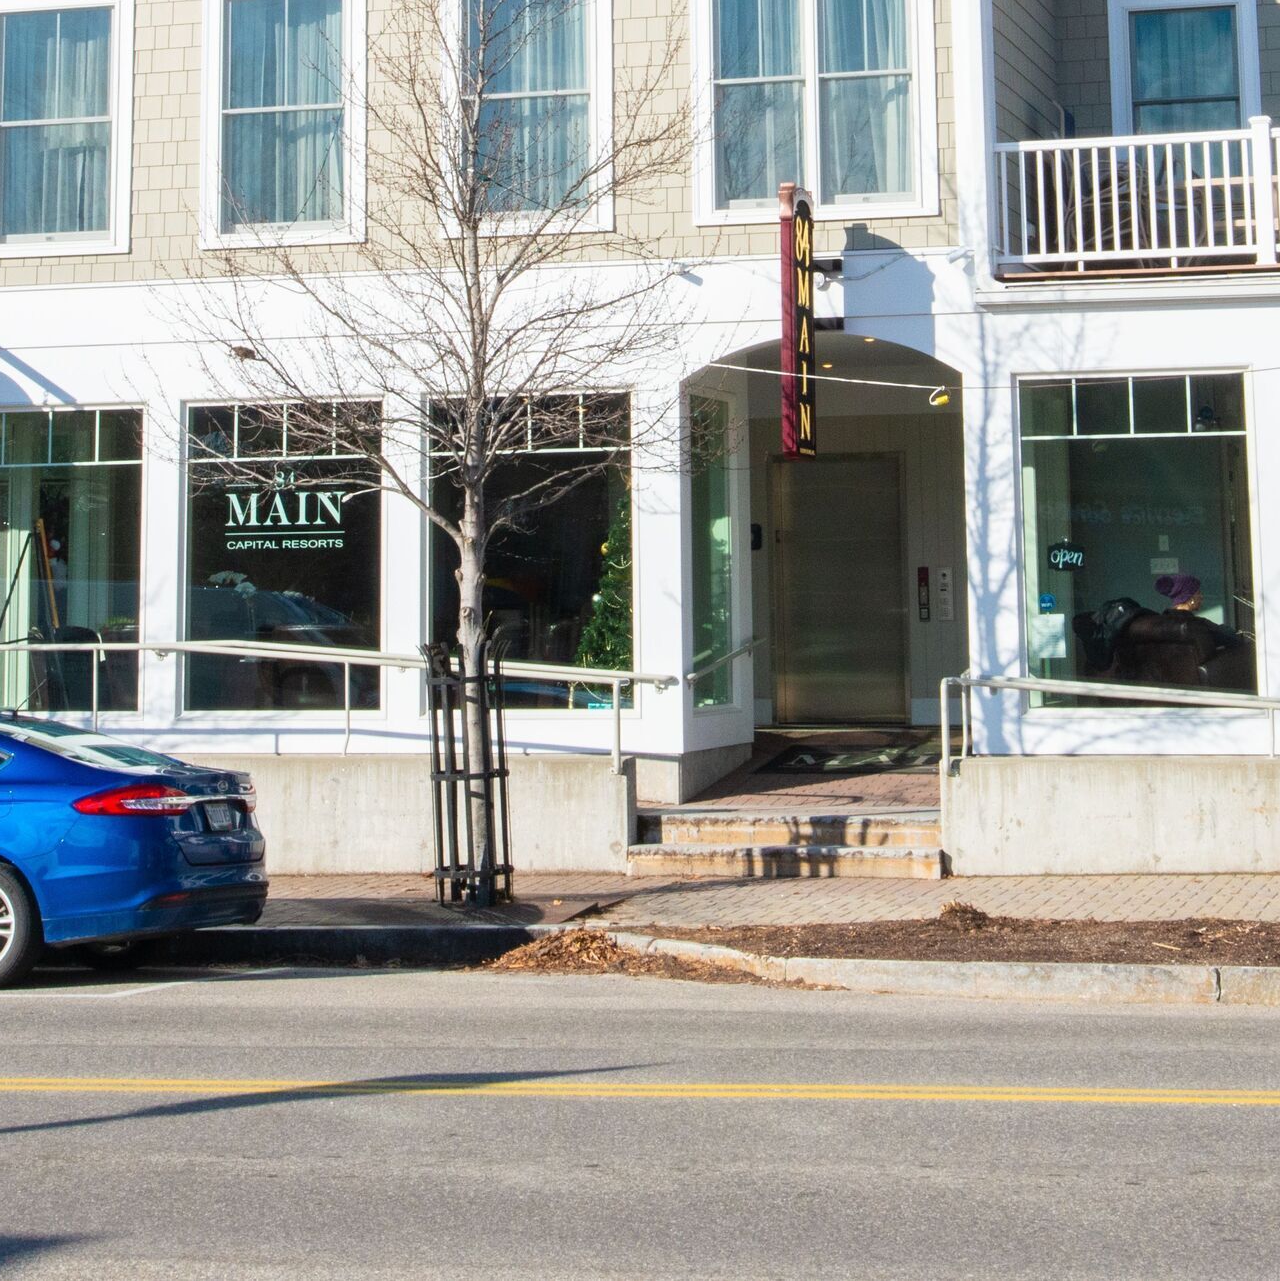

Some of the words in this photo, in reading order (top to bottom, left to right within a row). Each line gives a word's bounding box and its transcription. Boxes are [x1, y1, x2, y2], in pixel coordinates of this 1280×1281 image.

[795, 215, 811, 268] 84
[796, 267, 812, 441] MAIN
[225, 491, 346, 526] MAIN
[226, 540, 279, 550] CAPITAL
[282, 539, 344, 549] RESORTS
[1050, 549, 1084, 569] open
